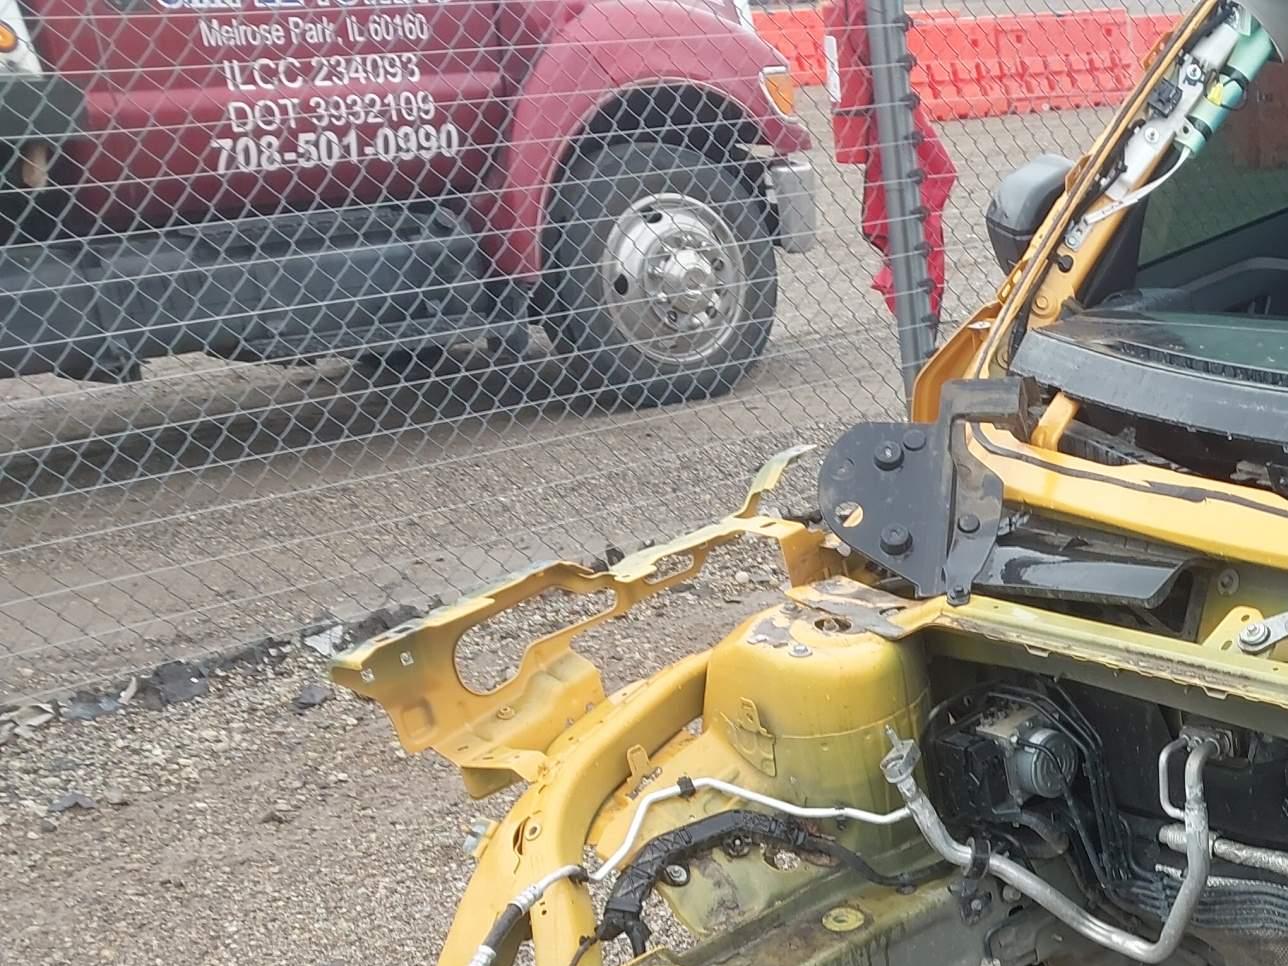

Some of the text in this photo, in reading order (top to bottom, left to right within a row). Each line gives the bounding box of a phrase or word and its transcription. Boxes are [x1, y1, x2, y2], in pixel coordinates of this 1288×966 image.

[199, 13, 429, 47] Melrose Park, IL 60160
[223, 53, 421, 92] ILCC 234093
[228, 91, 436, 132] DOT 3932109
[211, 122, 459, 174] 708-501-0990
